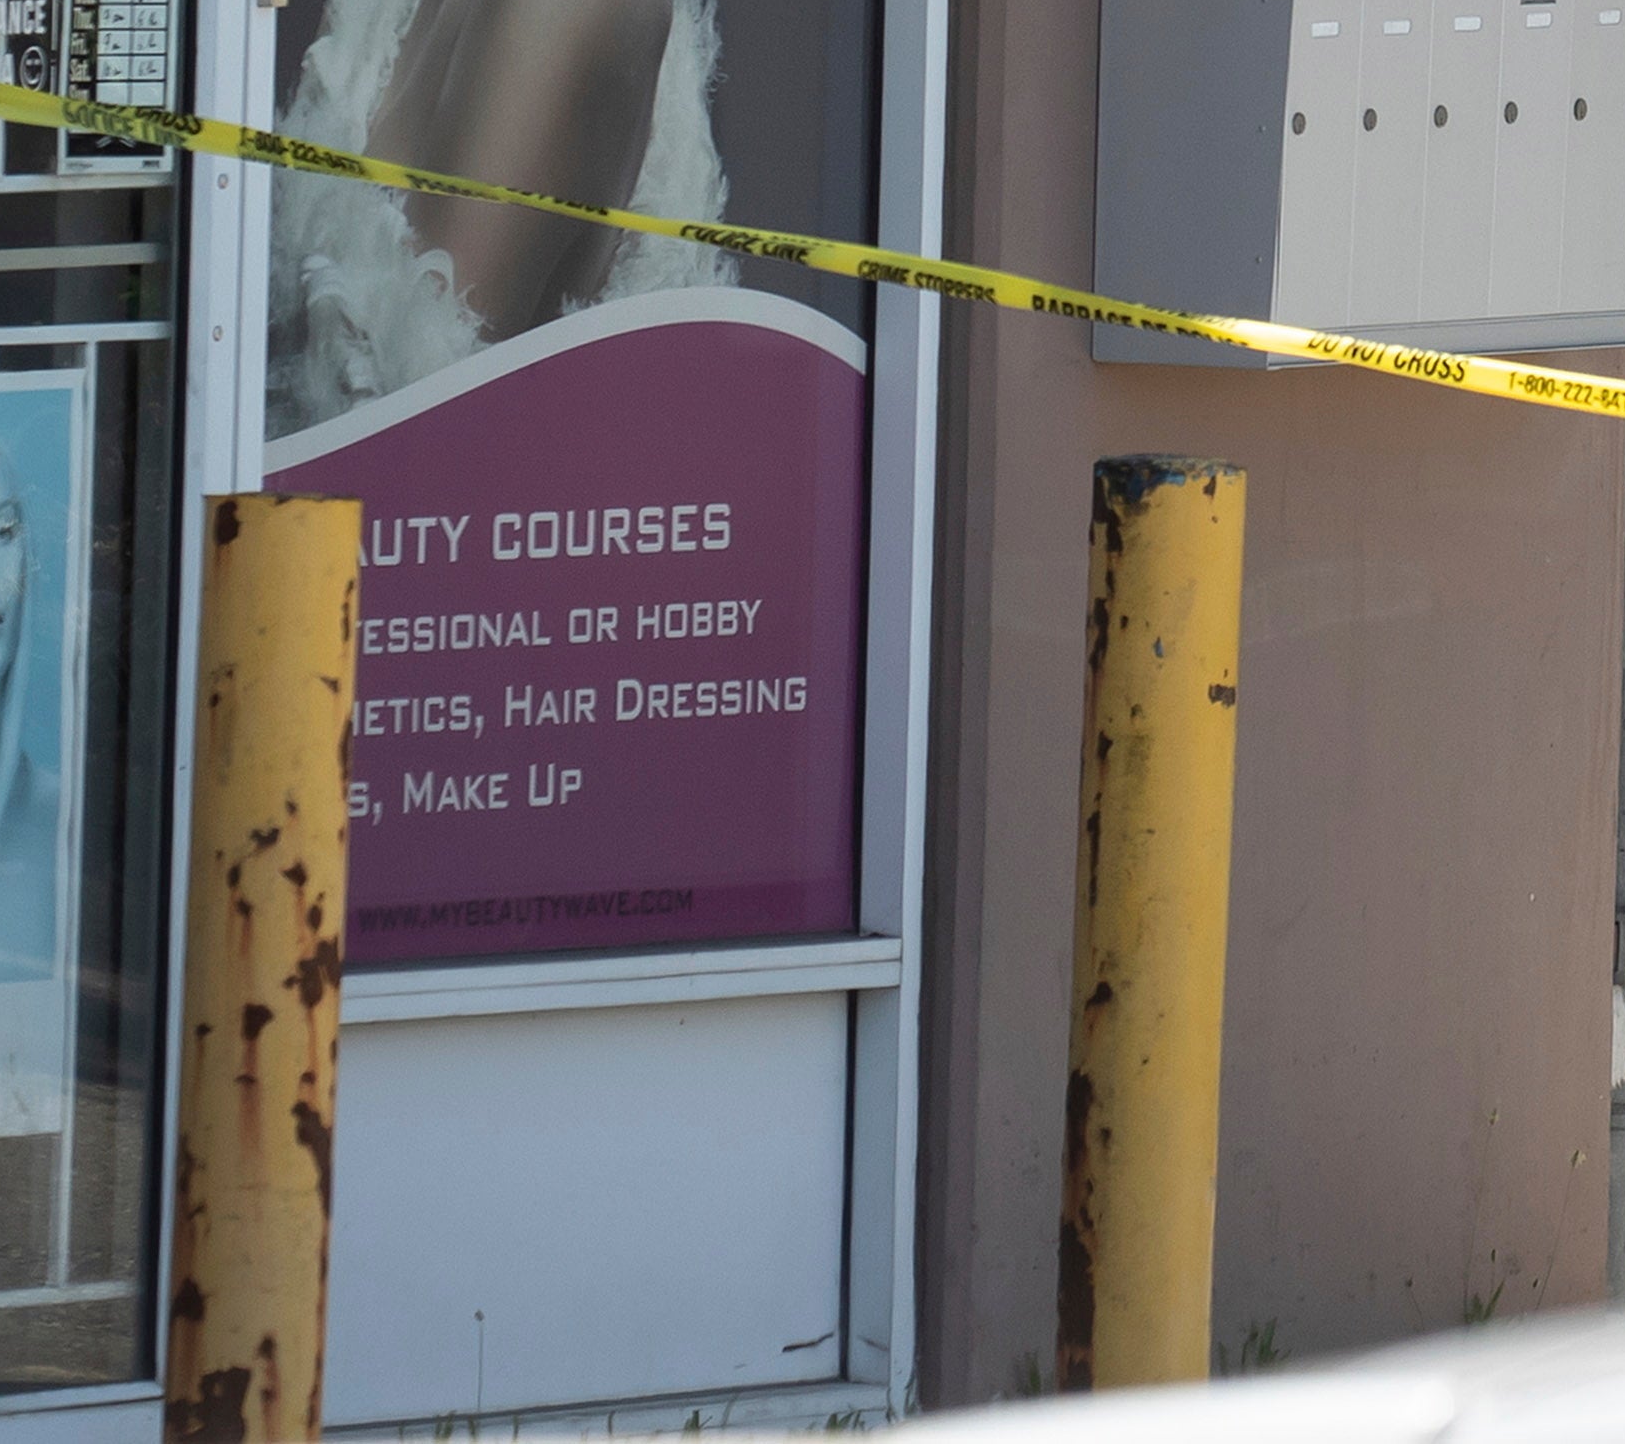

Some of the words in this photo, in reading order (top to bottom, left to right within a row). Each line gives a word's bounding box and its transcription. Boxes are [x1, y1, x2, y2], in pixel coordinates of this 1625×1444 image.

[857, 259, 910, 286] CRIME
[1394, 343, 1466, 382] CROSS
[492, 502, 733, 561] COURSES
[567, 605, 619, 645] OR
[636, 599, 764, 640] HOBBY
[503, 684, 597, 729] HAIR
[615, 676, 808, 722] DRESSING
[403, 771, 509, 814] MAKE
[527, 762, 583, 808] UP
